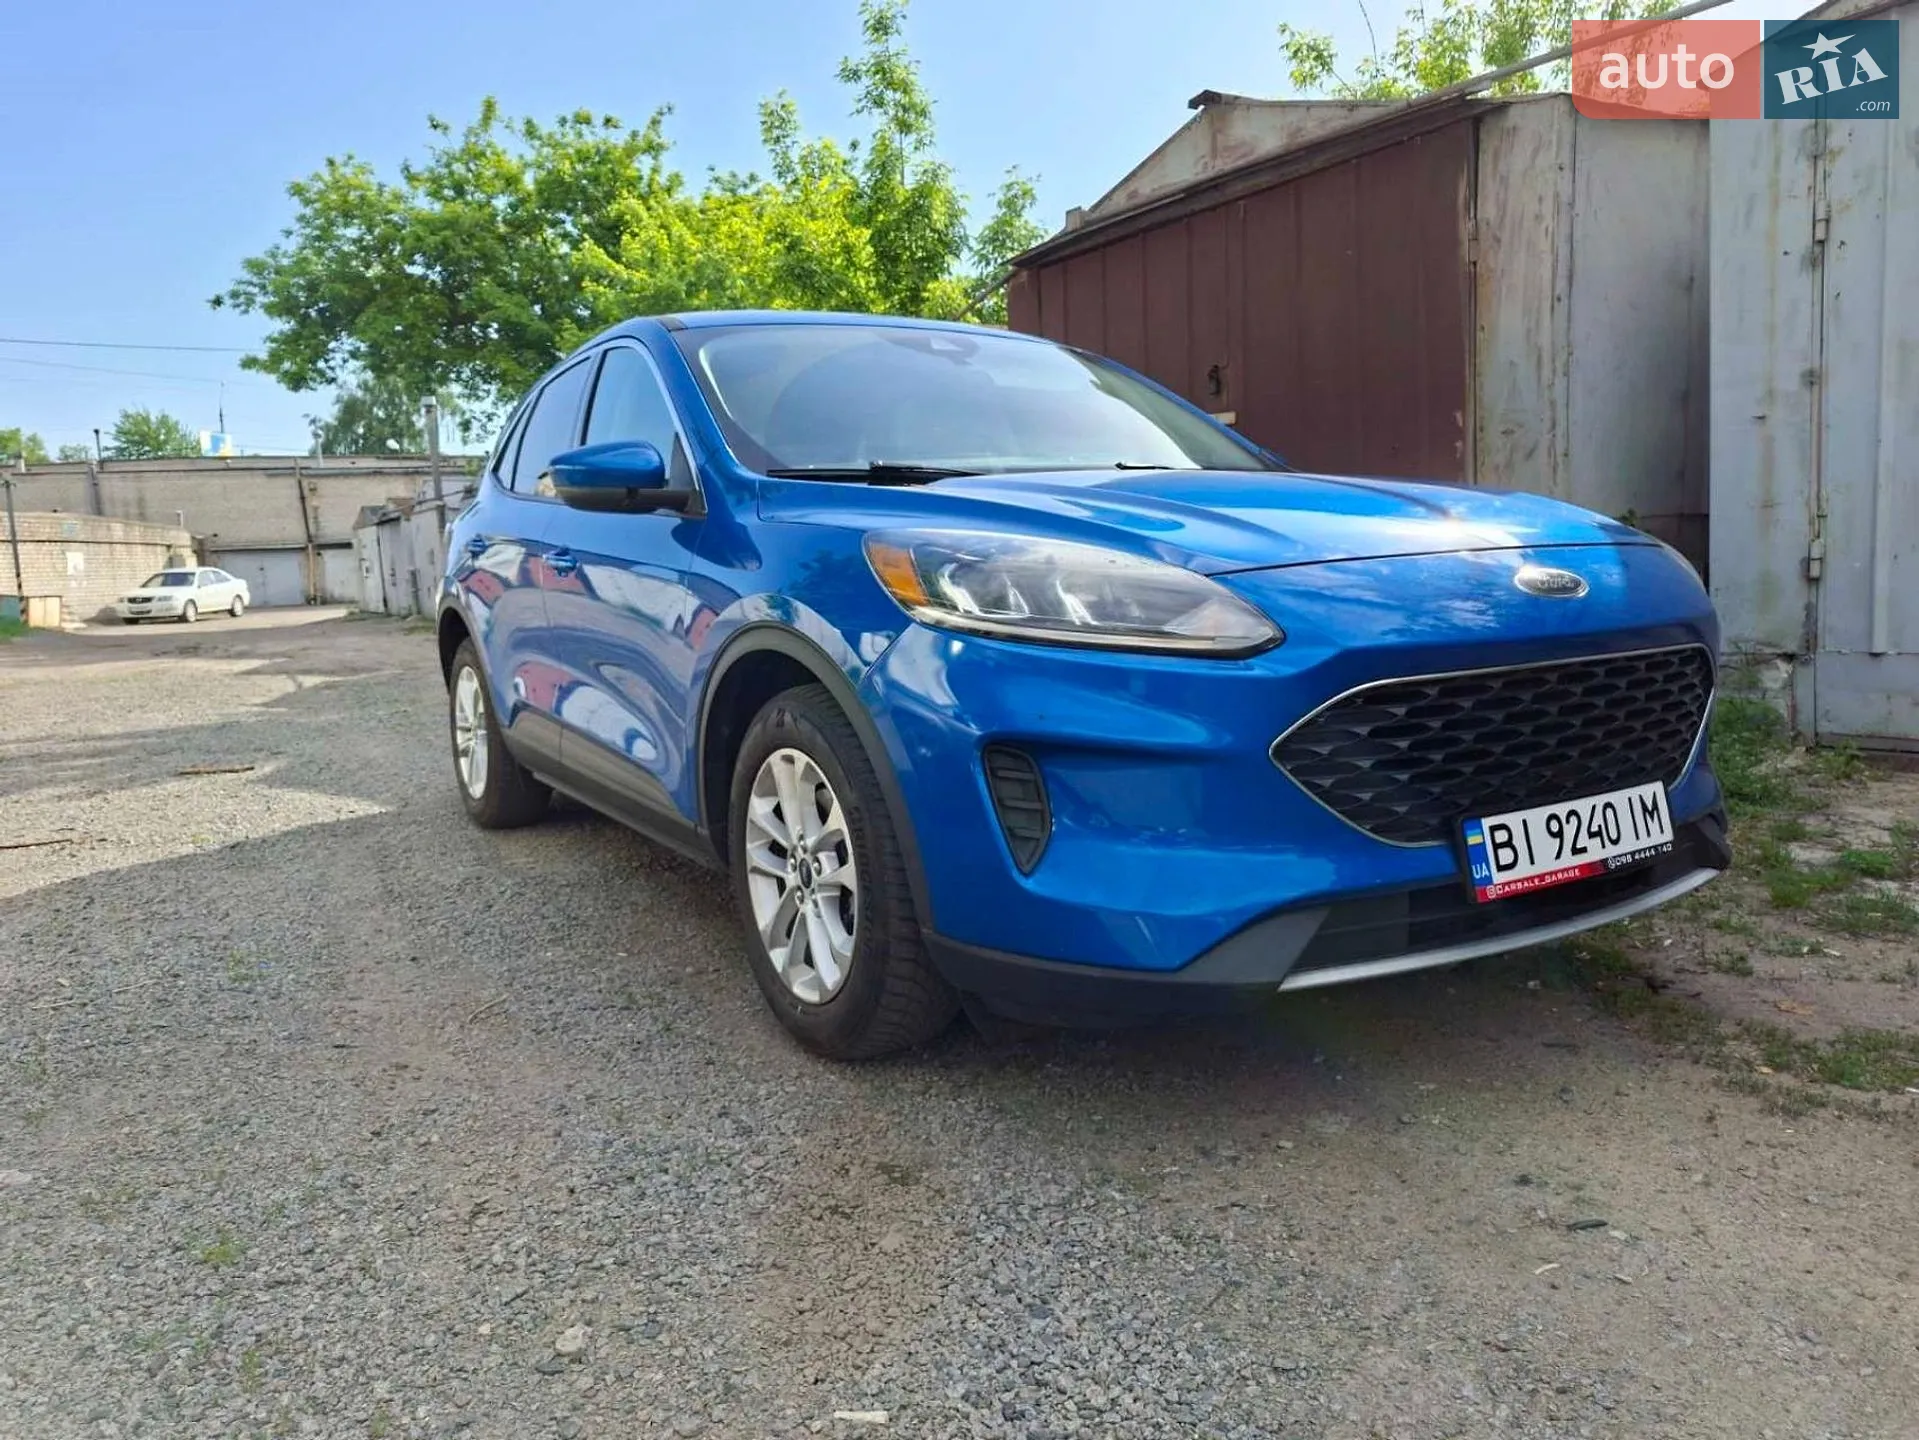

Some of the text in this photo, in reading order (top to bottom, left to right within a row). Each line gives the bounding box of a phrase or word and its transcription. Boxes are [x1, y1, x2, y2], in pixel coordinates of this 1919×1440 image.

[1488, 790, 1665, 873] BI 9240 IM
[1471, 864, 1491, 880] UA
